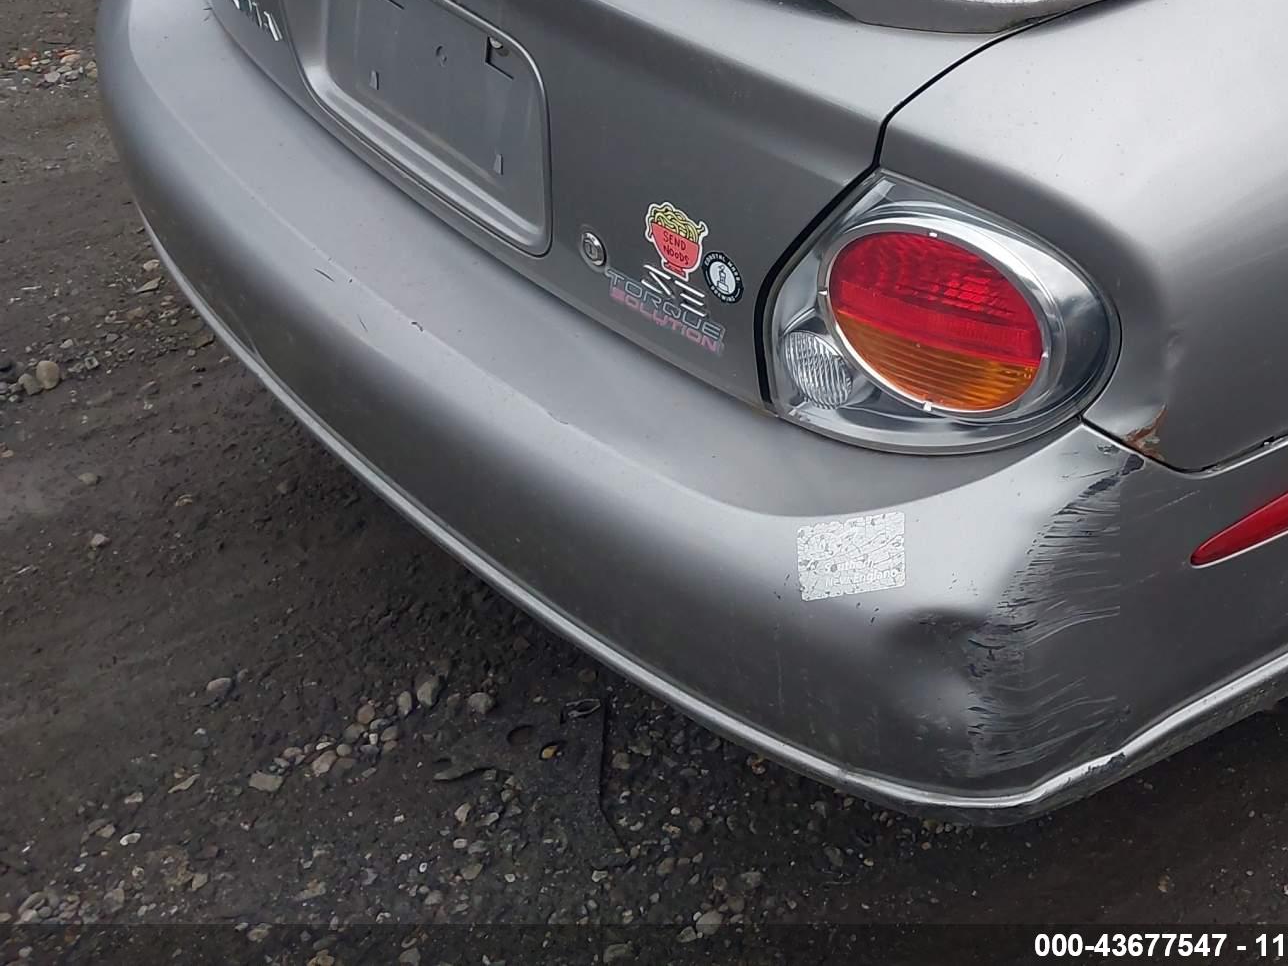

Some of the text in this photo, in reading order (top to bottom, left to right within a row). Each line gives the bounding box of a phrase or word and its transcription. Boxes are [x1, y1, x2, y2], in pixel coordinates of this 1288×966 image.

[663, 231, 686, 251] SEND
[606, 268, 722, 340] TORQUE
[611, 287, 719, 352] SOLUTION
